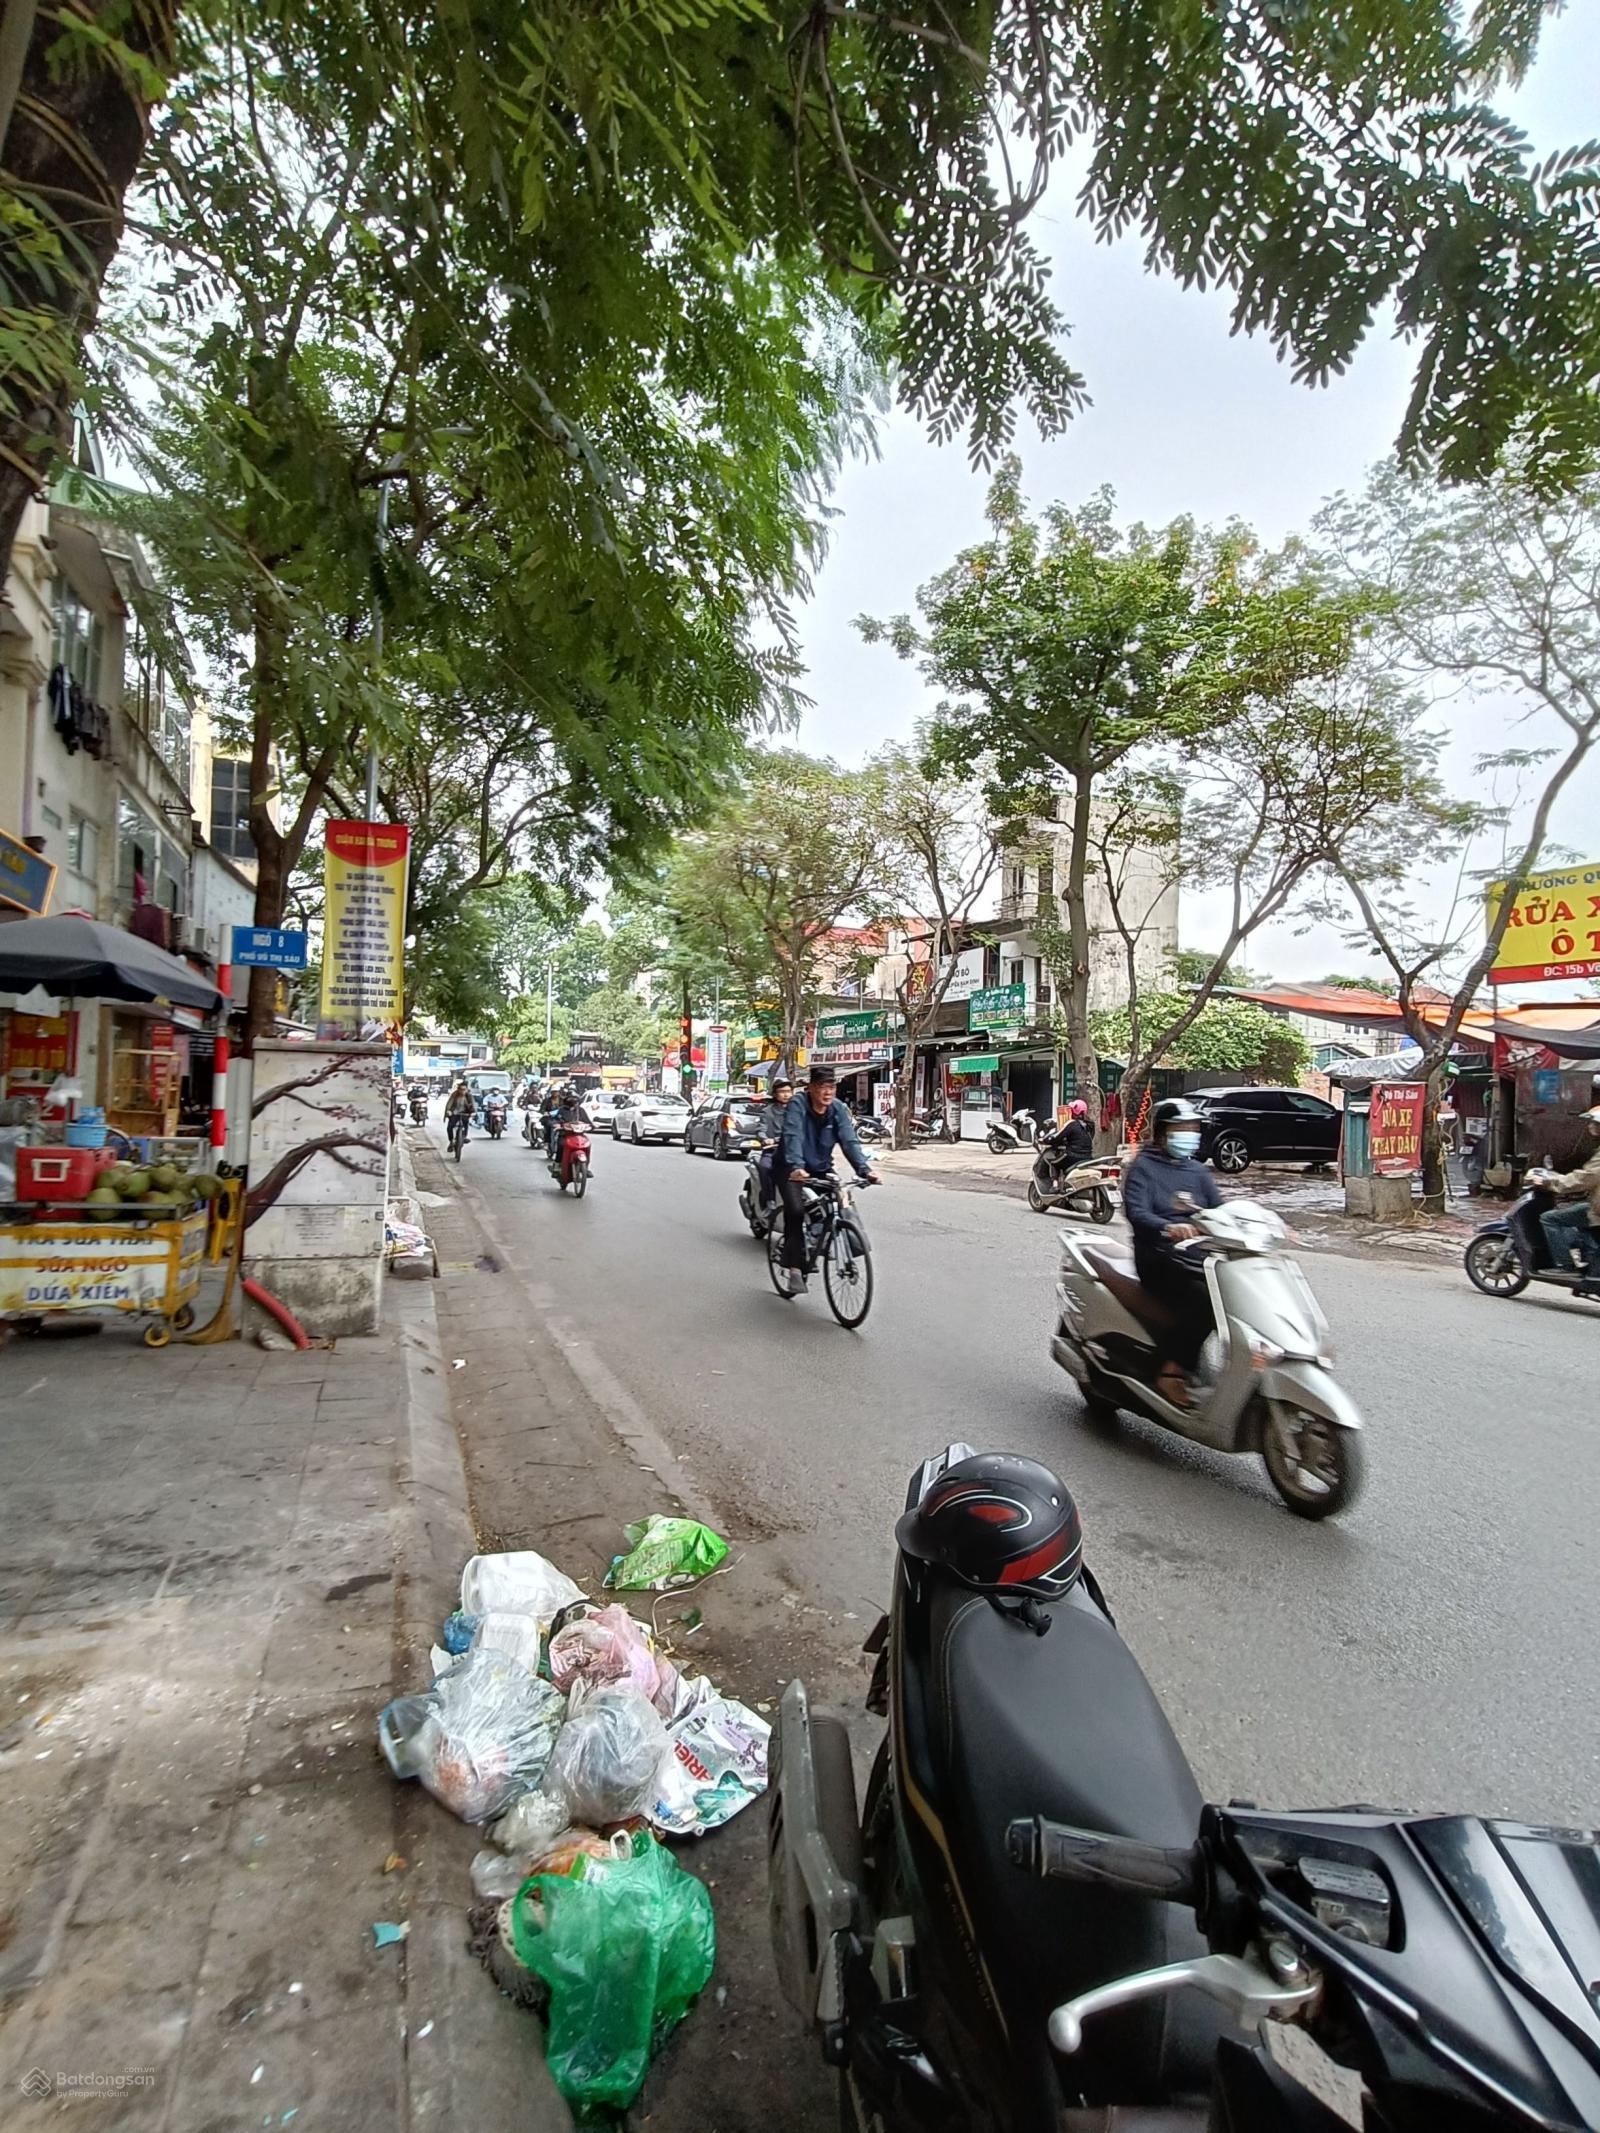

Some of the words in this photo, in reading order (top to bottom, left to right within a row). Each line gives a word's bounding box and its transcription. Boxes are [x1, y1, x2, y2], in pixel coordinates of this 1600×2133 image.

[1505, 896, 1576, 928] RỬA
[278, 935, 285, 948] 8
[1551, 928, 1575, 955] Ô
[1565, 963, 1584, 975] 15b
[674, 1739, 714, 1780] ARIEL
